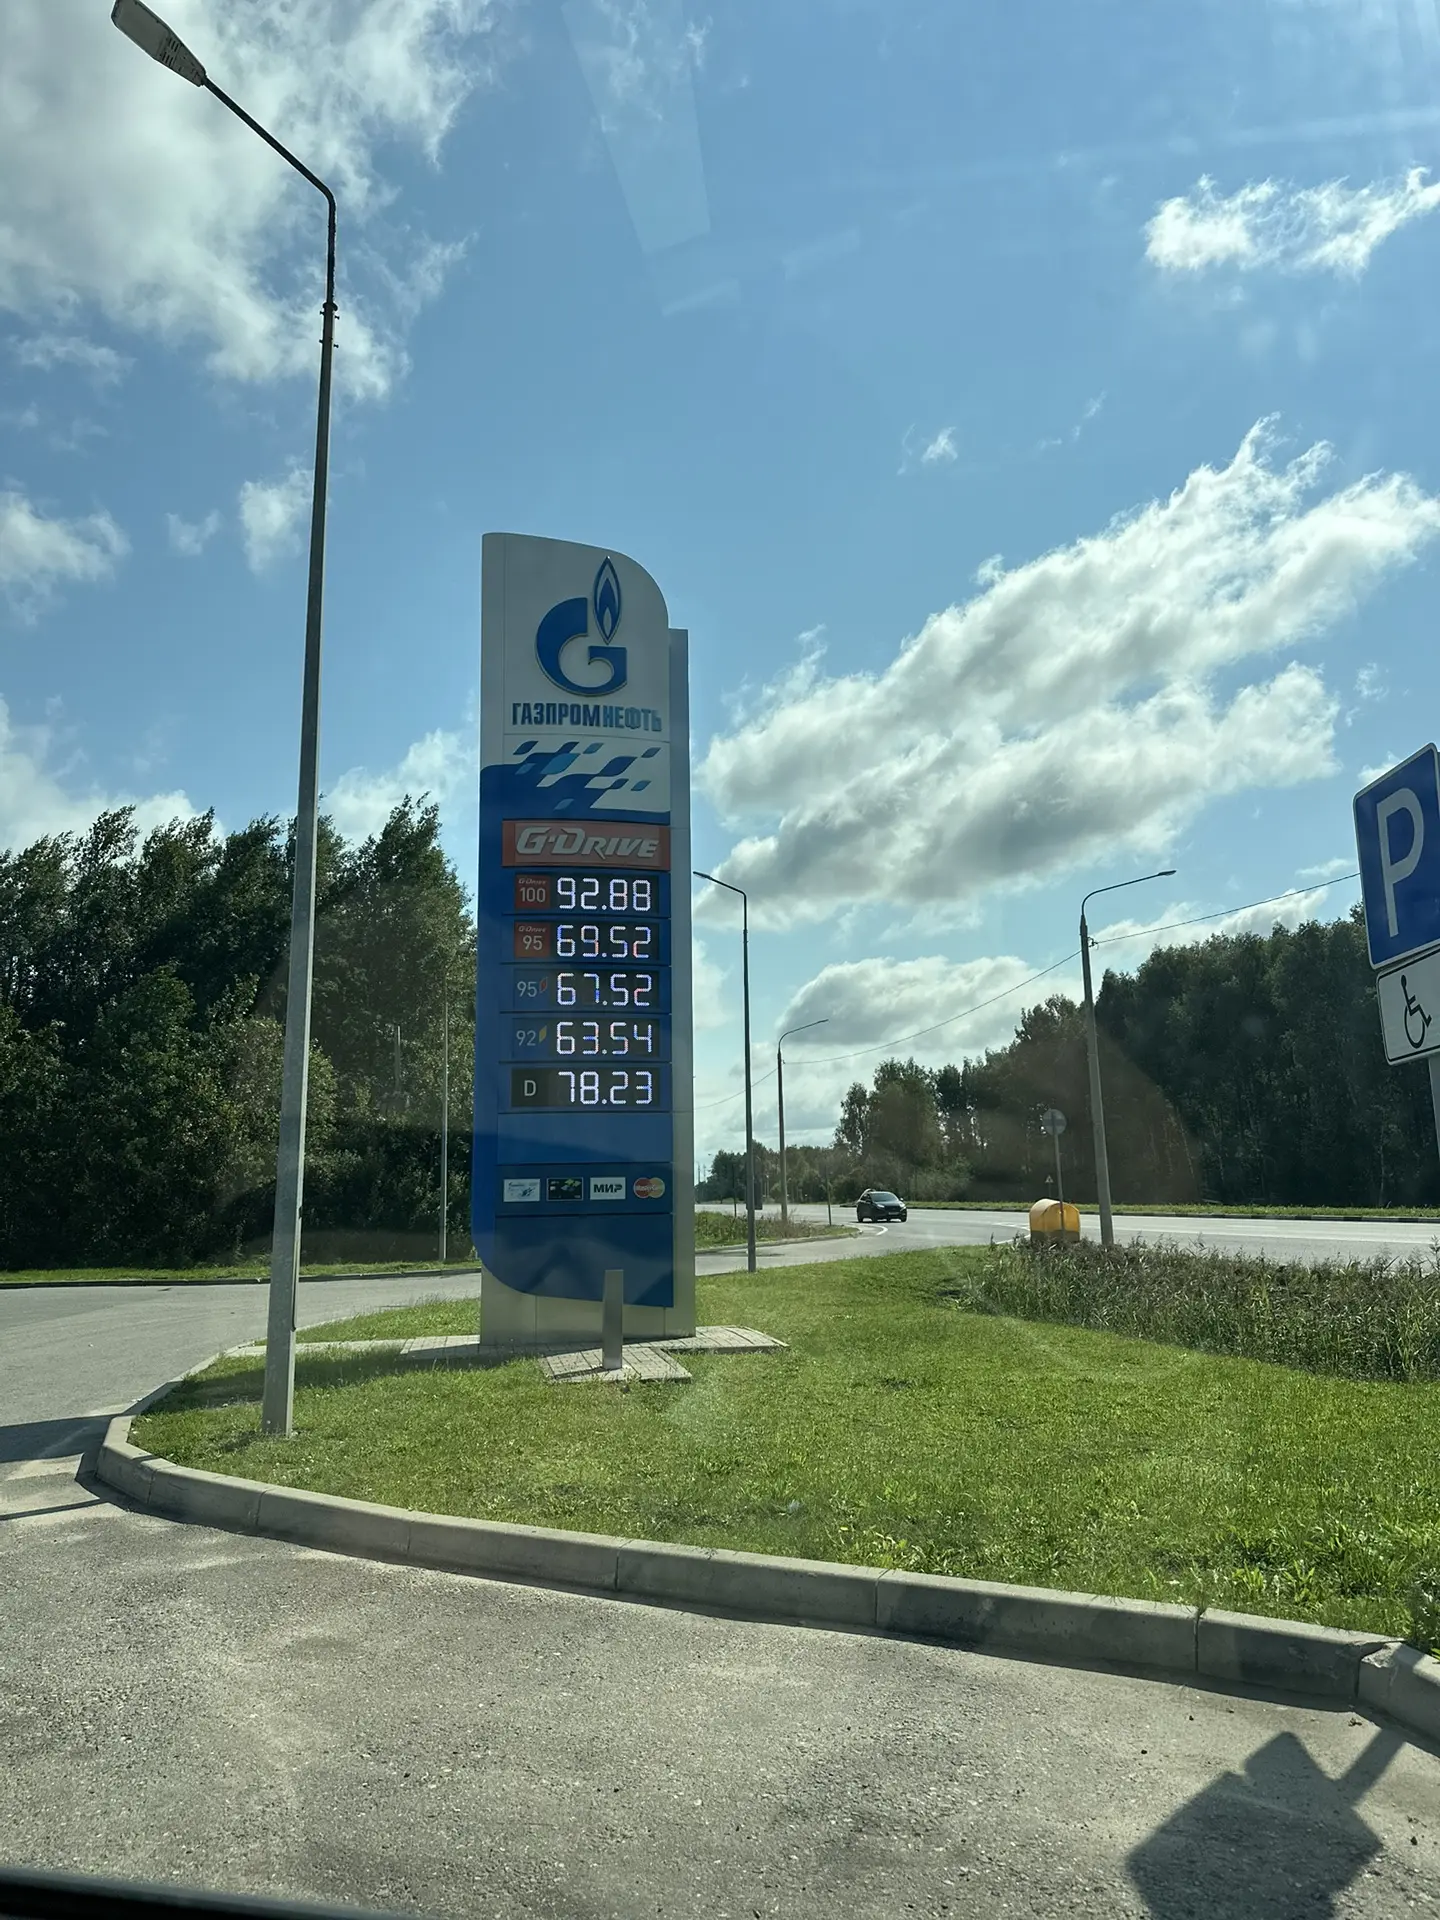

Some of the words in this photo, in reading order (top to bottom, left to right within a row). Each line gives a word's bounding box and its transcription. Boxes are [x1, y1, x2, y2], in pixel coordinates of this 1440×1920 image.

[512, 702, 662, 732] ГАЗПРОМНЕФТЬ
[519, 887, 546, 903] 100
[557, 877, 651, 911] 92.88
[522, 935, 543, 951] 95
[556, 925, 651, 958] 69.52
[516, 981, 537, 997] 95
[557, 973, 652, 1006] 67.52
[516, 1031, 536, 1047] 92
[556, 1022, 652, 1055] 63.54
[524, 1080, 537, 1096] D
[558, 1071, 652, 1105] 78.23
[593, 1184, 623, 1193] МИР
